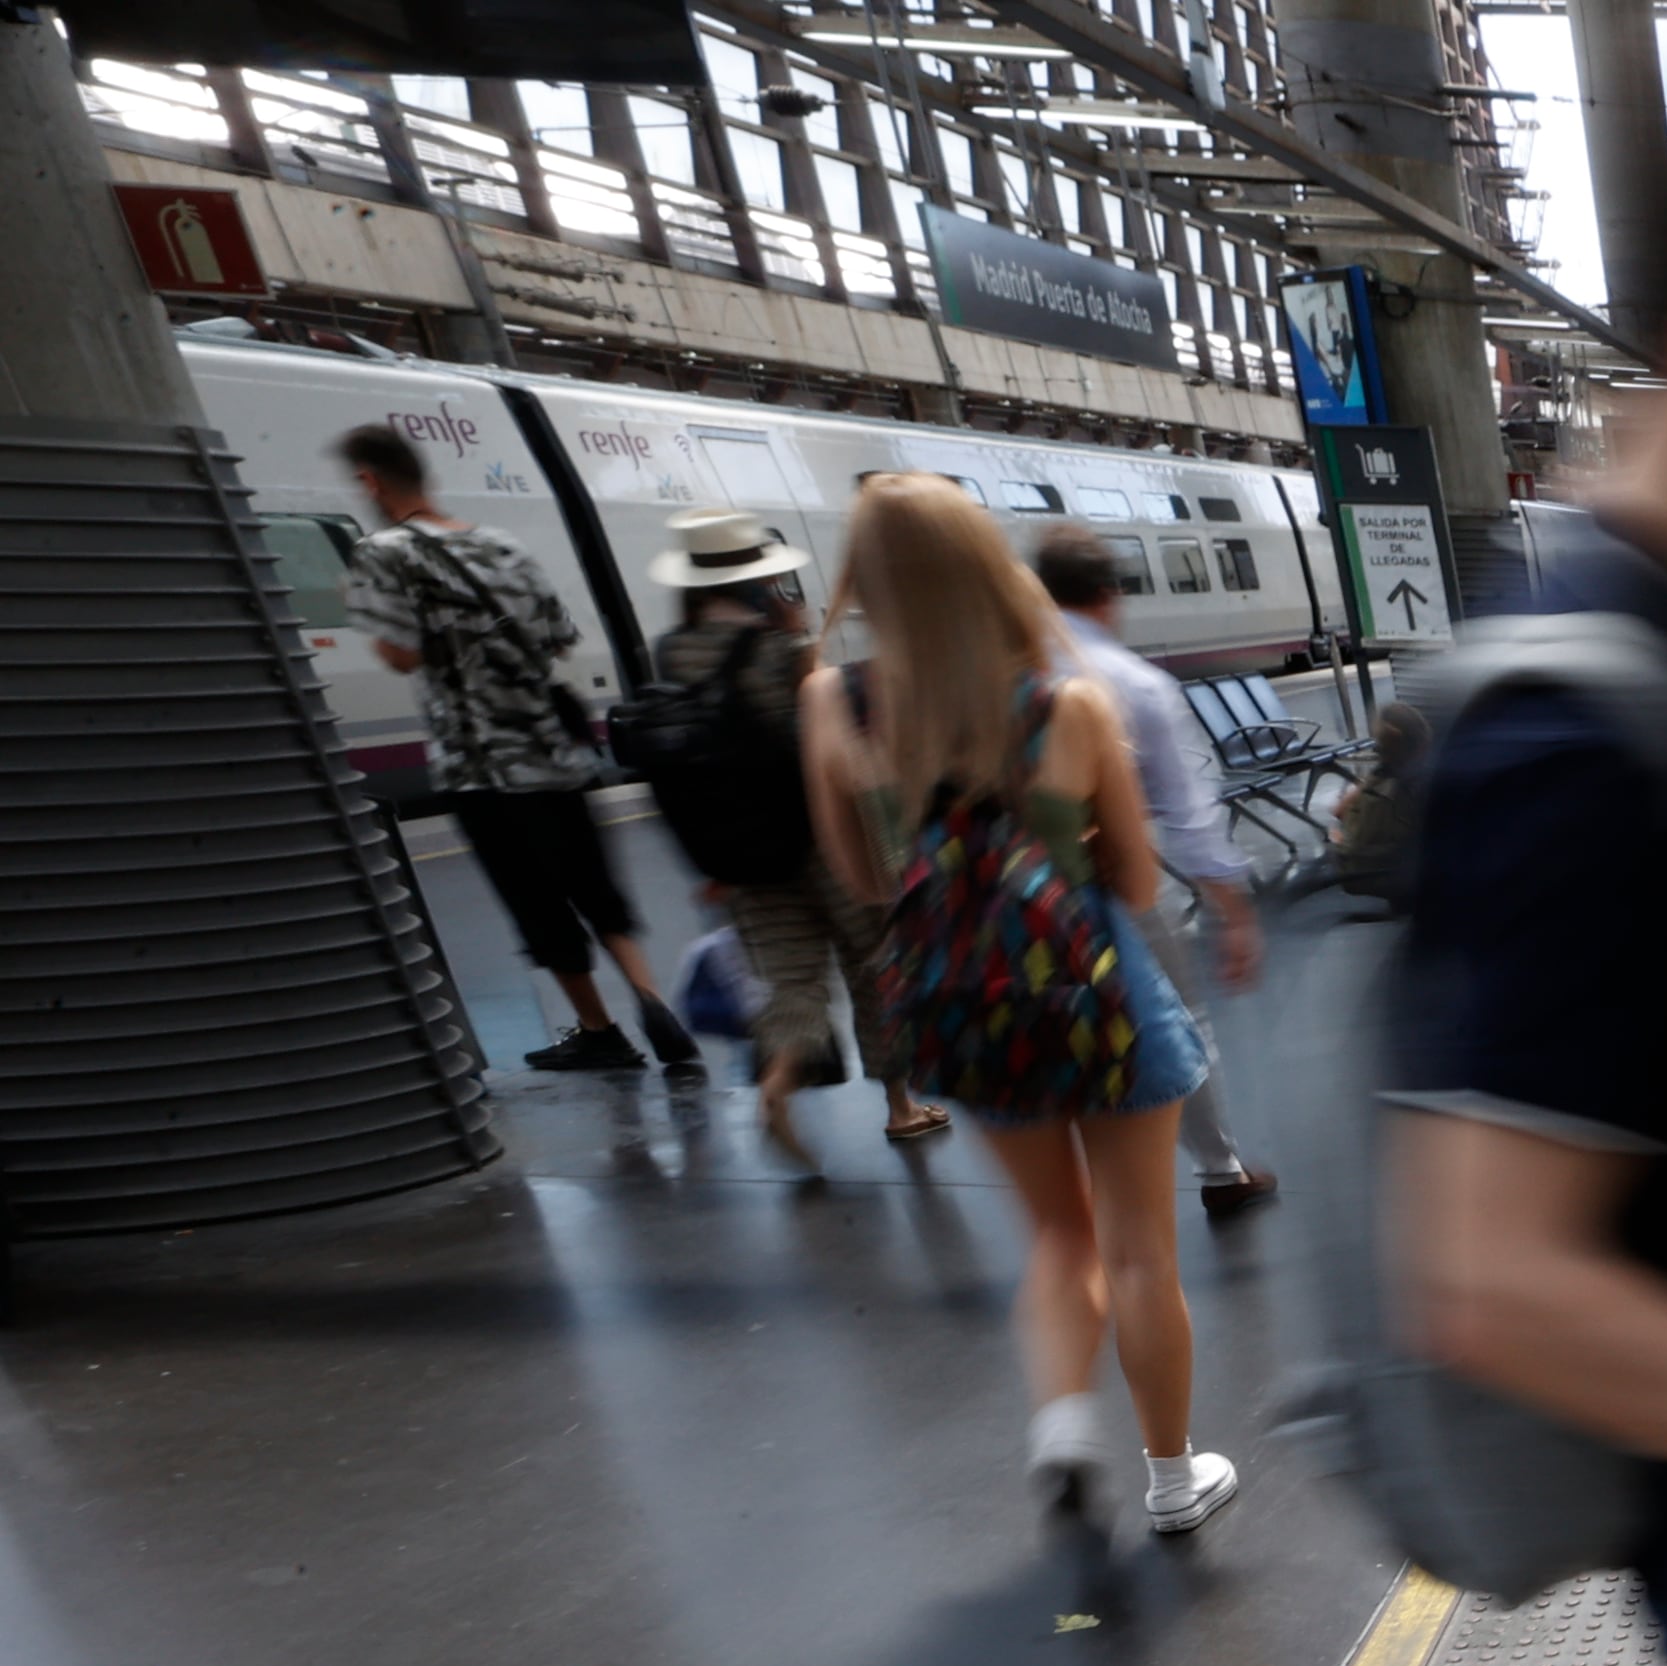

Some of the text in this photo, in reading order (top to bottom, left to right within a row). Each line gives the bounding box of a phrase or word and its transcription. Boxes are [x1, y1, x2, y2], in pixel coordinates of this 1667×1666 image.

[970, 252, 1153, 335] Madrid Puerta de Atocha
[387, 401, 480, 458] renfe
[578, 420, 652, 470] renfe
[485, 465, 531, 493] AVE
[657, 477, 694, 501] AVE
[1359, 517, 1426, 528] SALIDA POR
[1367, 531, 1423, 541] TERMINAL
[1390, 543, 1405, 553] DE
[1370, 556, 1430, 567] LLEGADAS
